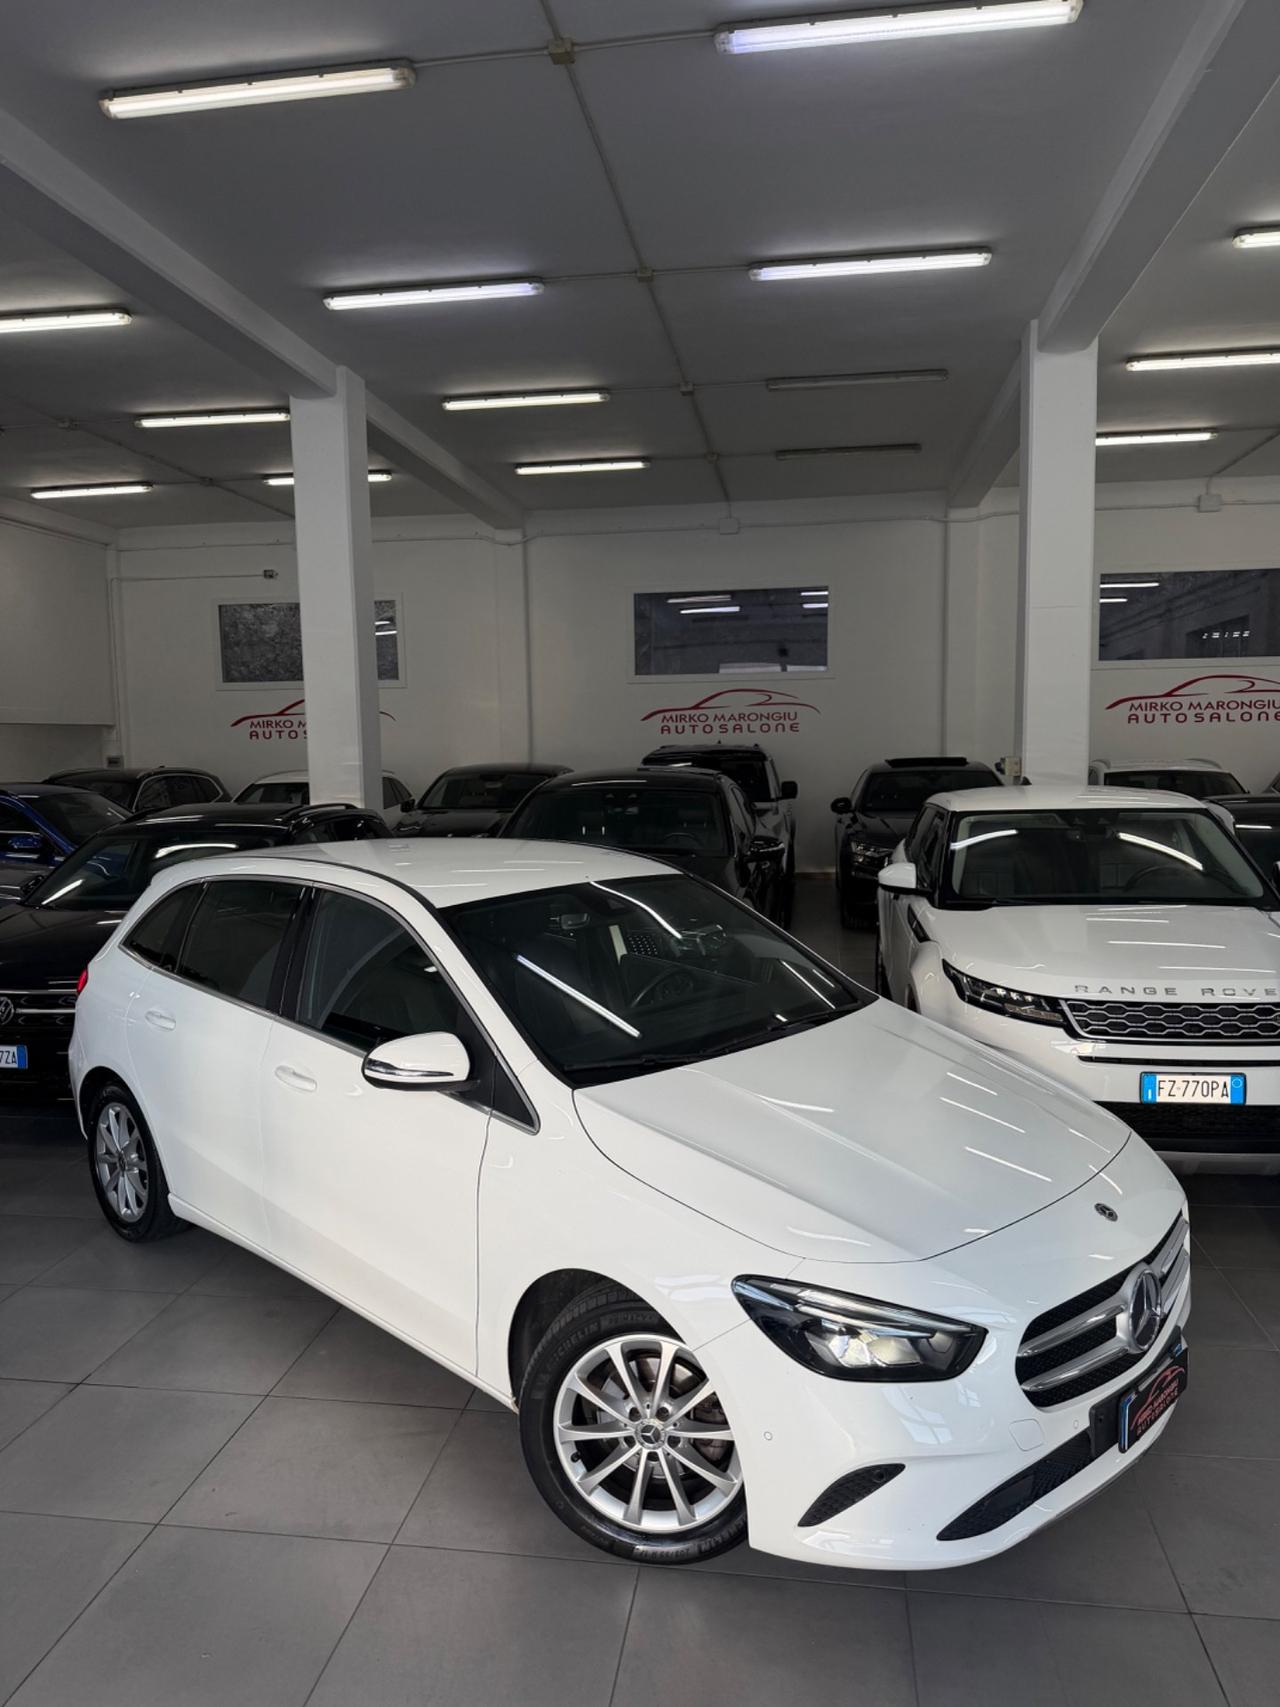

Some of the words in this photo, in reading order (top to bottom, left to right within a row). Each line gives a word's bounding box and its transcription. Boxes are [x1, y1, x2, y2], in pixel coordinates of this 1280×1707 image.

[1129, 701, 1183, 712] MIRKO
[661, 713, 709, 723] MIRKO
[713, 711, 798, 723] MARONGIU
[250, 719, 293, 729] MIRKO
[660, 723, 800, 735] AUTOSALONE
[1074, 985, 1178, 996] RANGE
